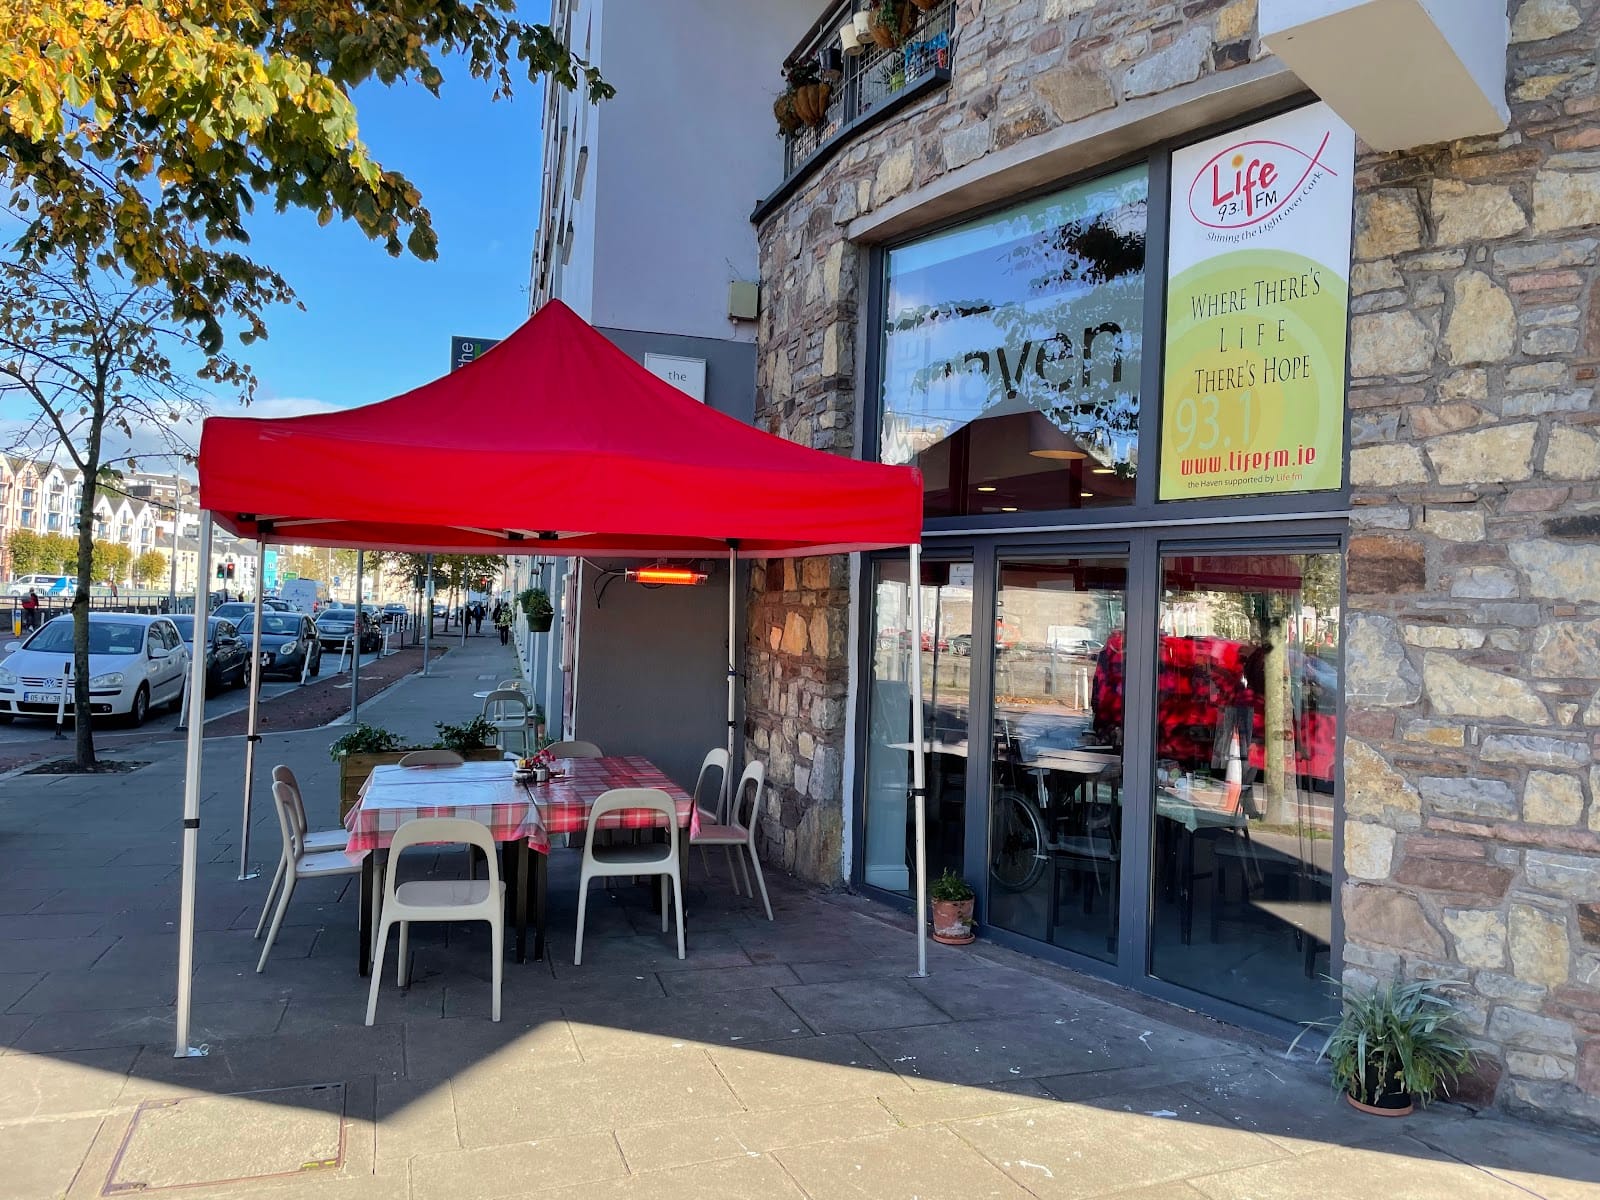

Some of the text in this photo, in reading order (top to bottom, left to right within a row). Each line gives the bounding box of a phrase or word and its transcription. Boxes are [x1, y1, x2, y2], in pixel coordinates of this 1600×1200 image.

[1212, 154, 1278, 217] Life
[1206, 171, 1323, 243] Shining the Light over Cork
[1218, 191, 1277, 222] 93.1 FM
[1191, 267, 1320, 320] WHERE THERE'S
[668, 371, 687, 381] the
[1194, 355, 1310, 394] THERE'S HOPE
[1175, 390, 1251, 453] 93.1
[1181, 444, 1316, 476] www.lifefm.ie
[1188, 480, 1200, 488] the
[1200, 479, 1223, 488] Haven
[1224, 475, 1263, 488] supported
[1264, 475, 1275, 484] by
